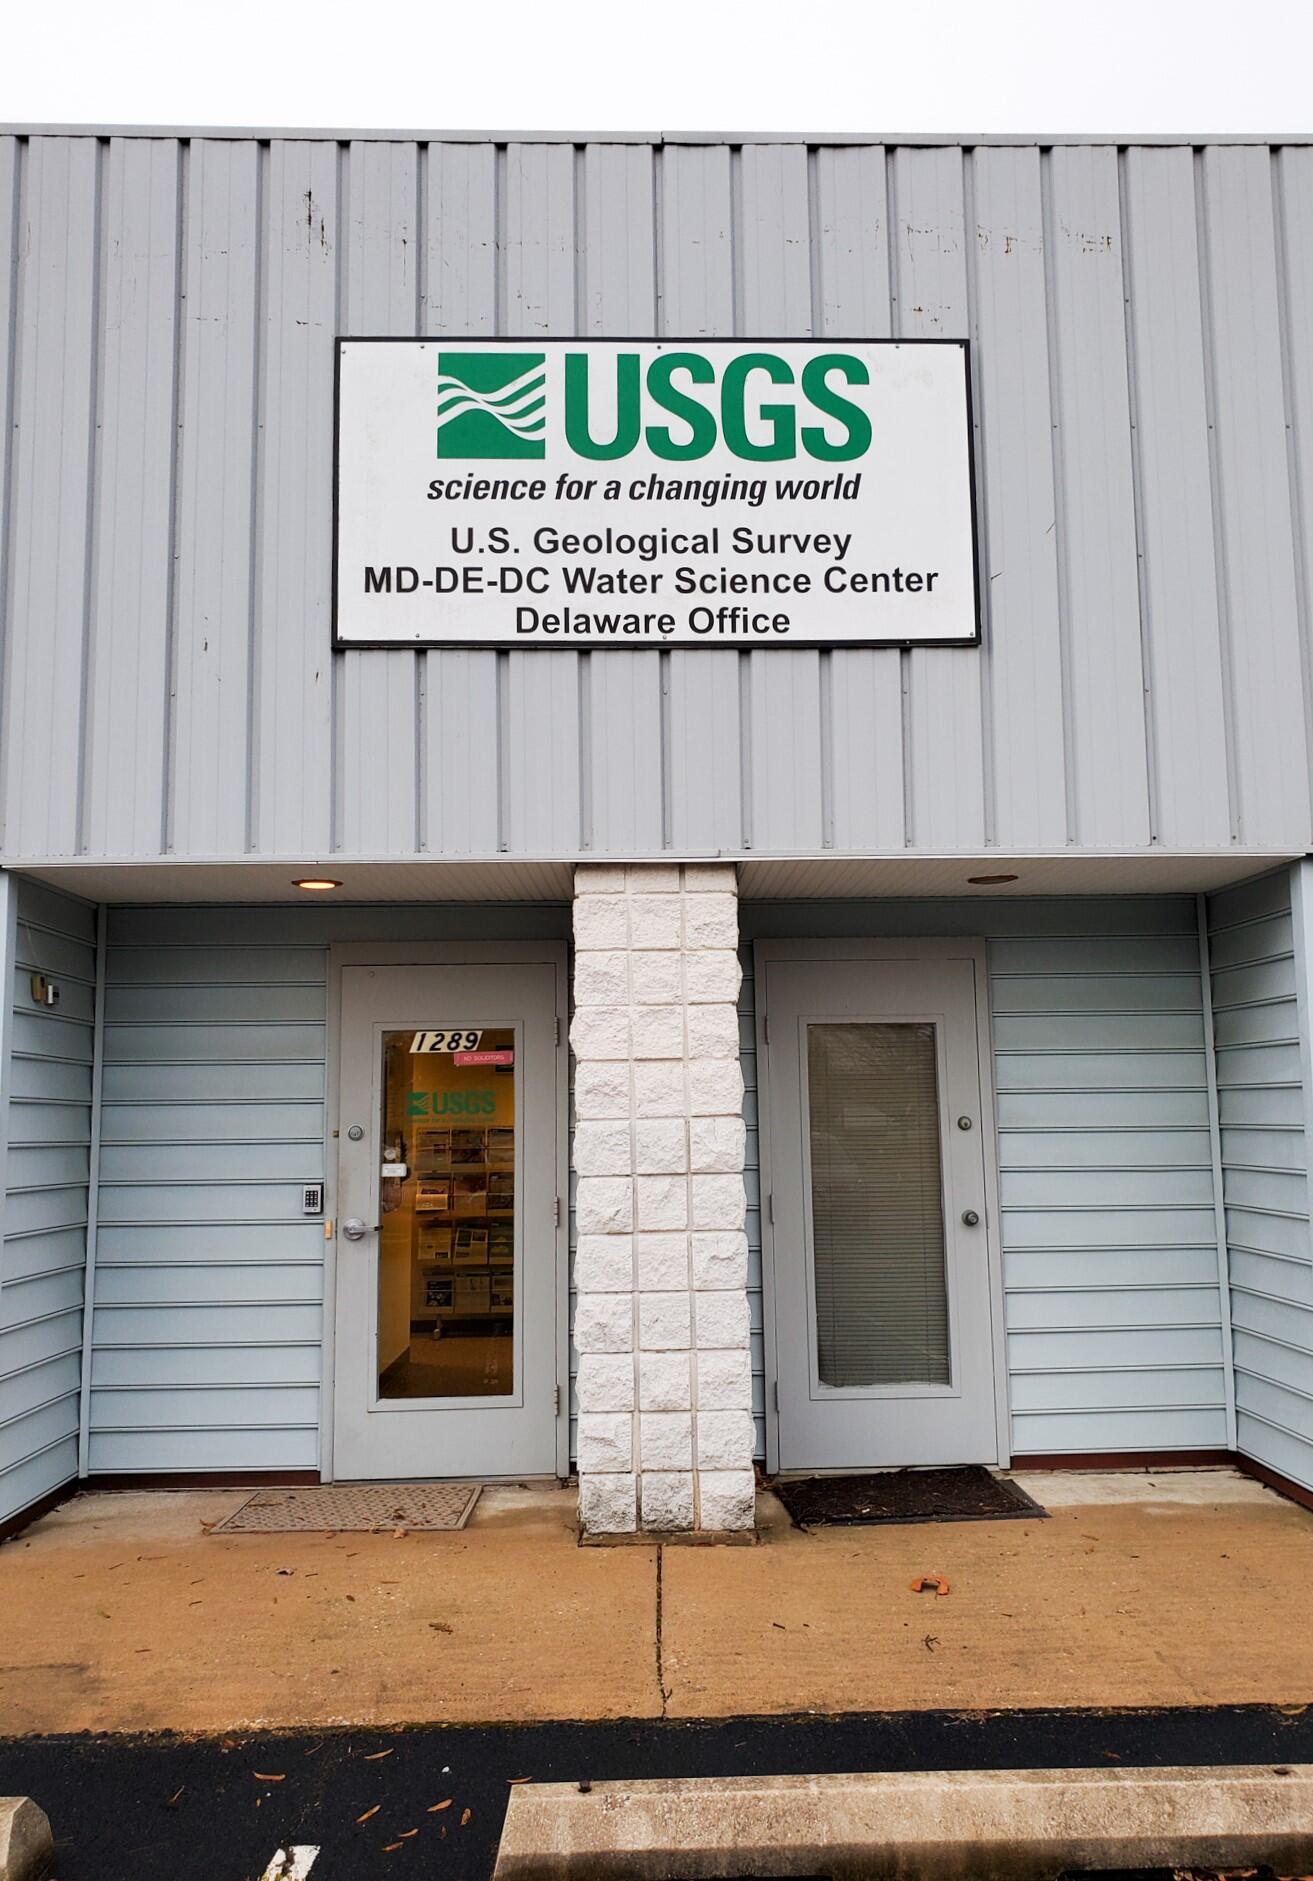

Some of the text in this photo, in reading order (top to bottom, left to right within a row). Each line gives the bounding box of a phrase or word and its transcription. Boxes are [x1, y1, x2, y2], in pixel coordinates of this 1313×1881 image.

[565, 352, 873, 462] USGS
[428, 473, 862, 507] science for a changing world
[451, 527, 852, 561] U.S. Geological Survey
[364, 566, 939, 594] MD-DE-DC Water Science Center
[516, 606, 791, 634] Delaware Office
[416, 1032, 479, 1051] 1289
[432, 1090, 497, 1114] USGS
